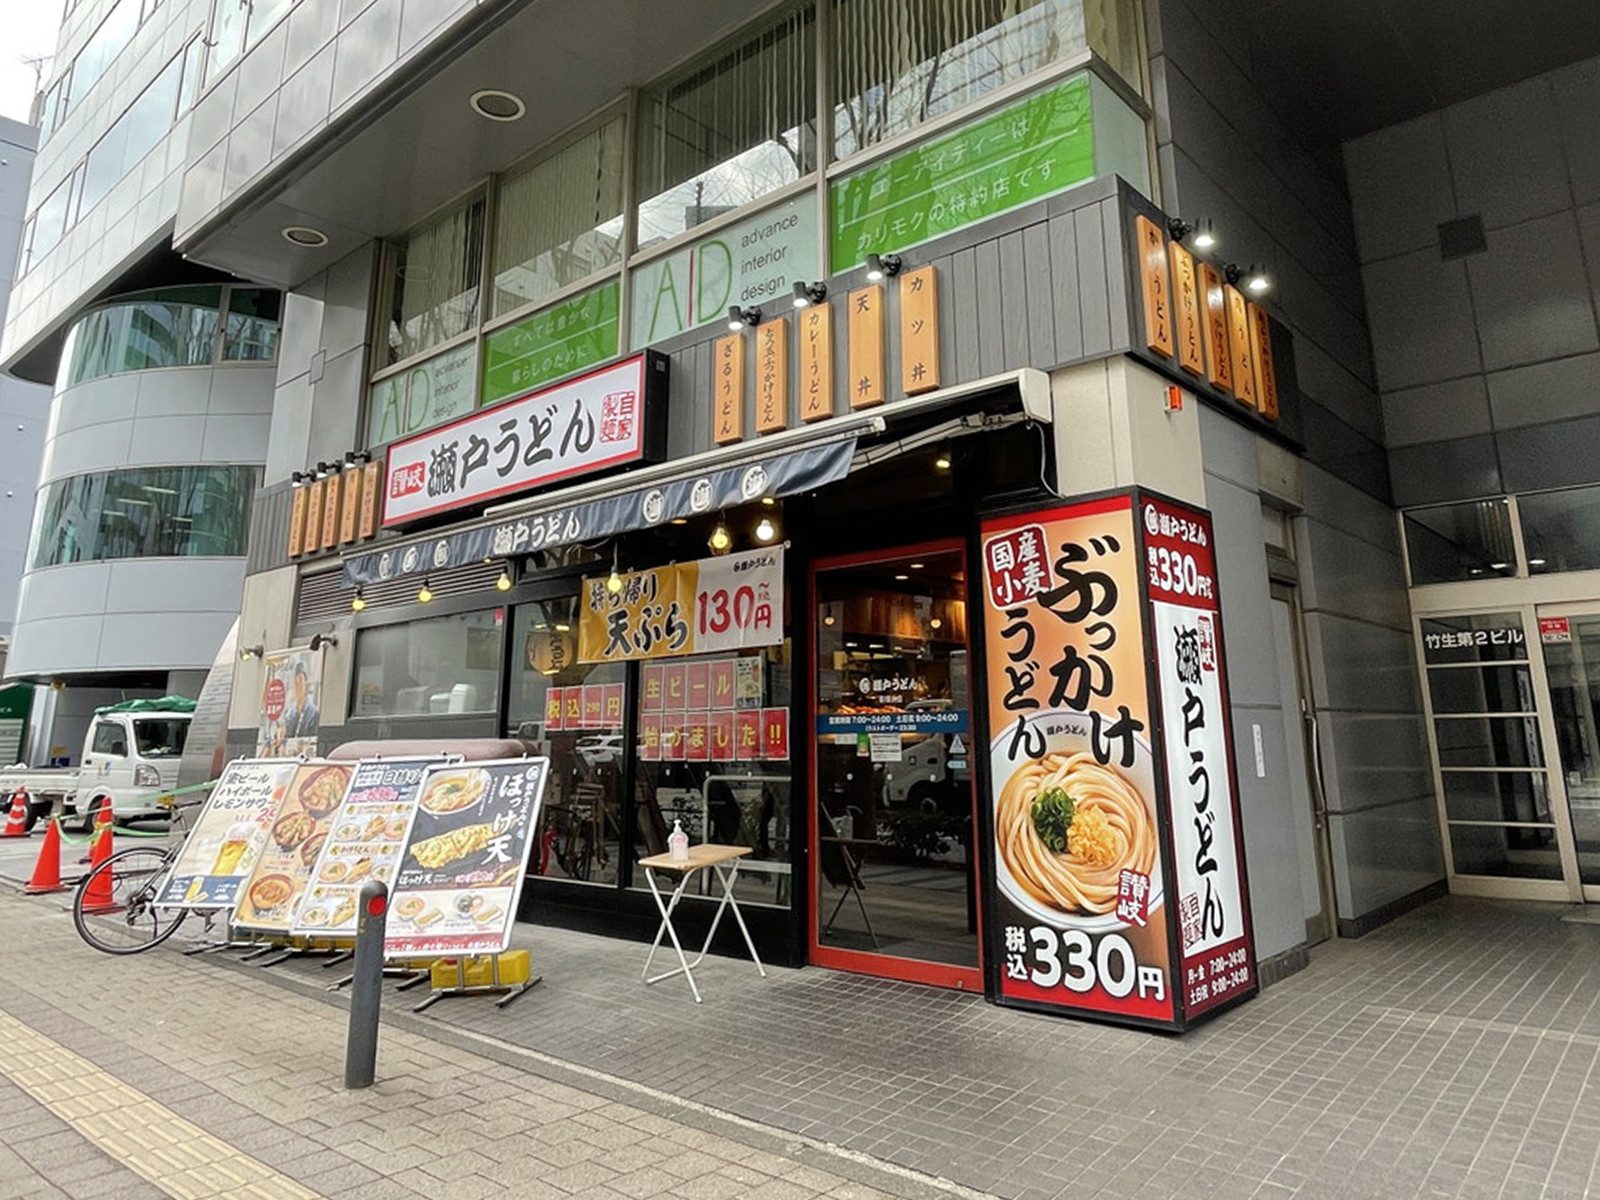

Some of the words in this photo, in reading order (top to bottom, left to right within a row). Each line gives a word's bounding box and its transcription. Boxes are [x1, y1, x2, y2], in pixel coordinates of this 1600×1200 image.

[741, 213, 799, 249] advance
[741, 245, 788, 275] interior
[648, 239, 733, 344] AID
[741, 275, 786, 302] design
[720, 341, 735, 436] ざるうどん
[808, 312, 820, 412] カレーうどん
[427, 398, 596, 498] 瀬戸うどん
[493, 511, 581, 555] 瀬戸うどん
[991, 531, 1040, 571] 国産
[996, 562, 1050, 605] 小麦
[604, 602, 690, 658] 天ぷら
[1036, 535, 1145, 768] ぶっかけ
[1425, 629, 1524, 649] 竹生第2ビル
[646, 674, 731, 699] 生ビール
[1000, 607, 1047, 761] うどん
[218, 785, 273, 797] ハイボール
[1174, 624, 1224, 941] 瀬戸うどん
[480, 773, 525, 866] ほっけ天
[1005, 926, 1029, 982] 税込
[1030, 926, 1166, 1002] 330円
